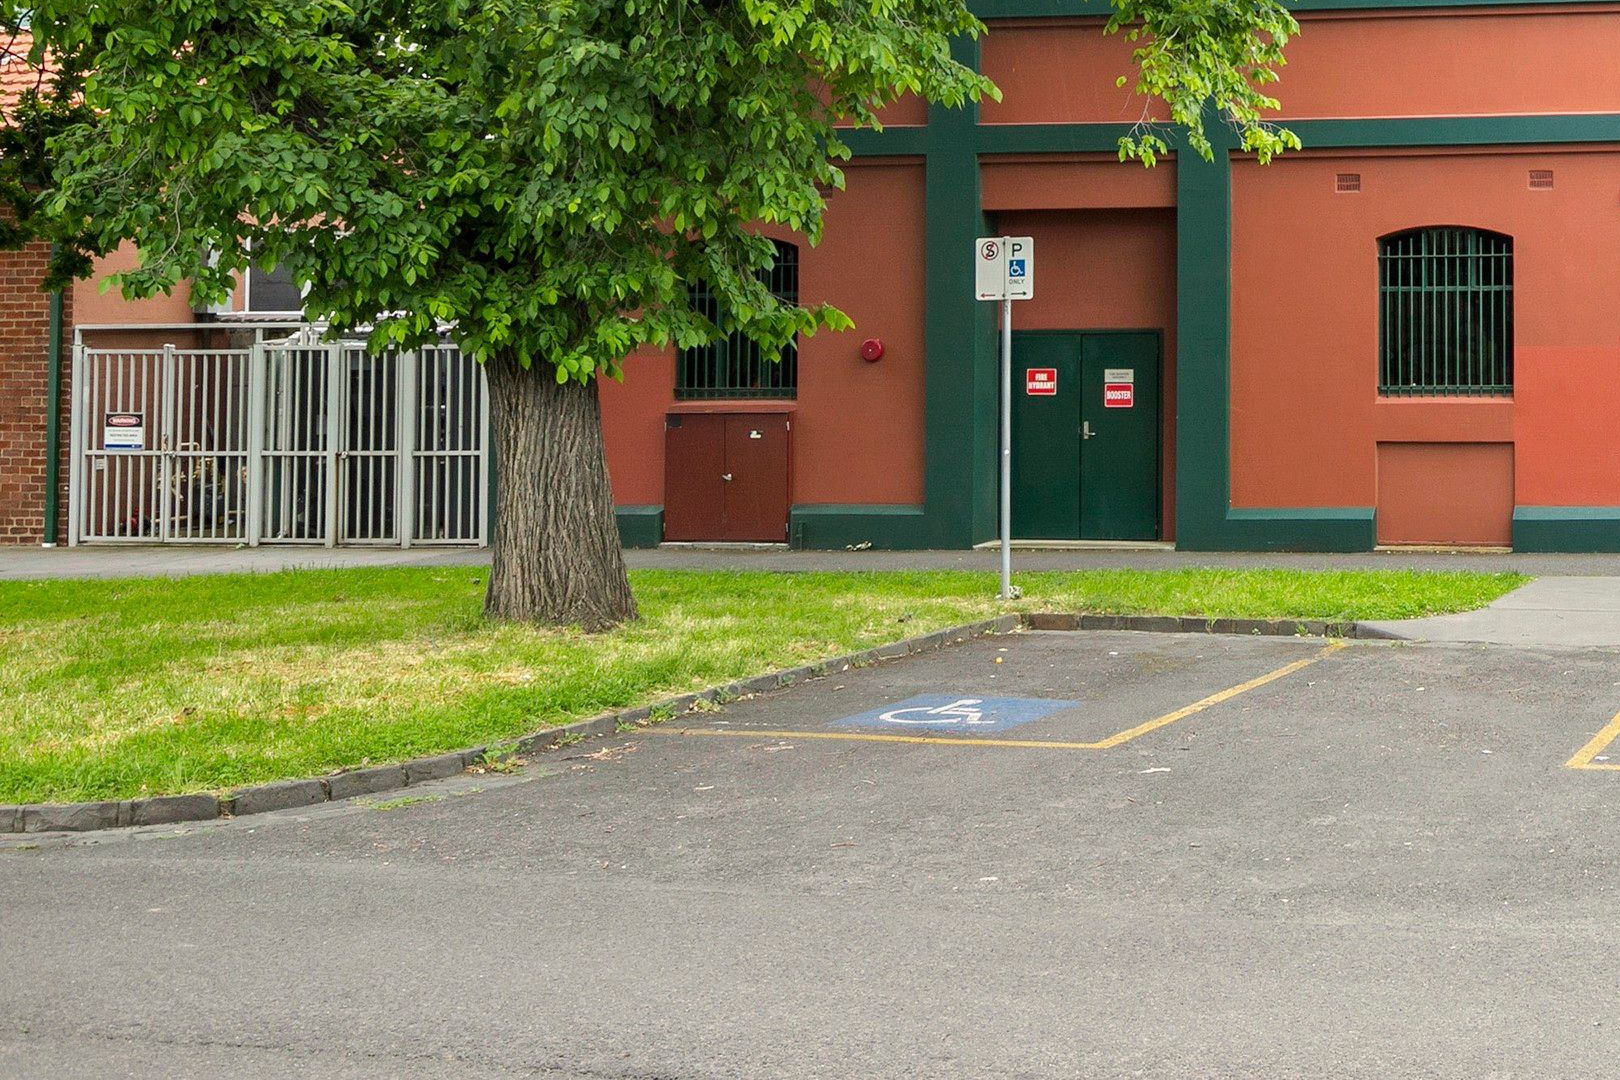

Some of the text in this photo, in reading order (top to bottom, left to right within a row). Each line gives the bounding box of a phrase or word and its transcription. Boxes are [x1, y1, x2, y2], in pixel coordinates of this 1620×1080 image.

[1012, 243, 1022, 257] P
[1035, 373, 1048, 381] FIRE
[1106, 390, 1131, 400] BOOSTER
